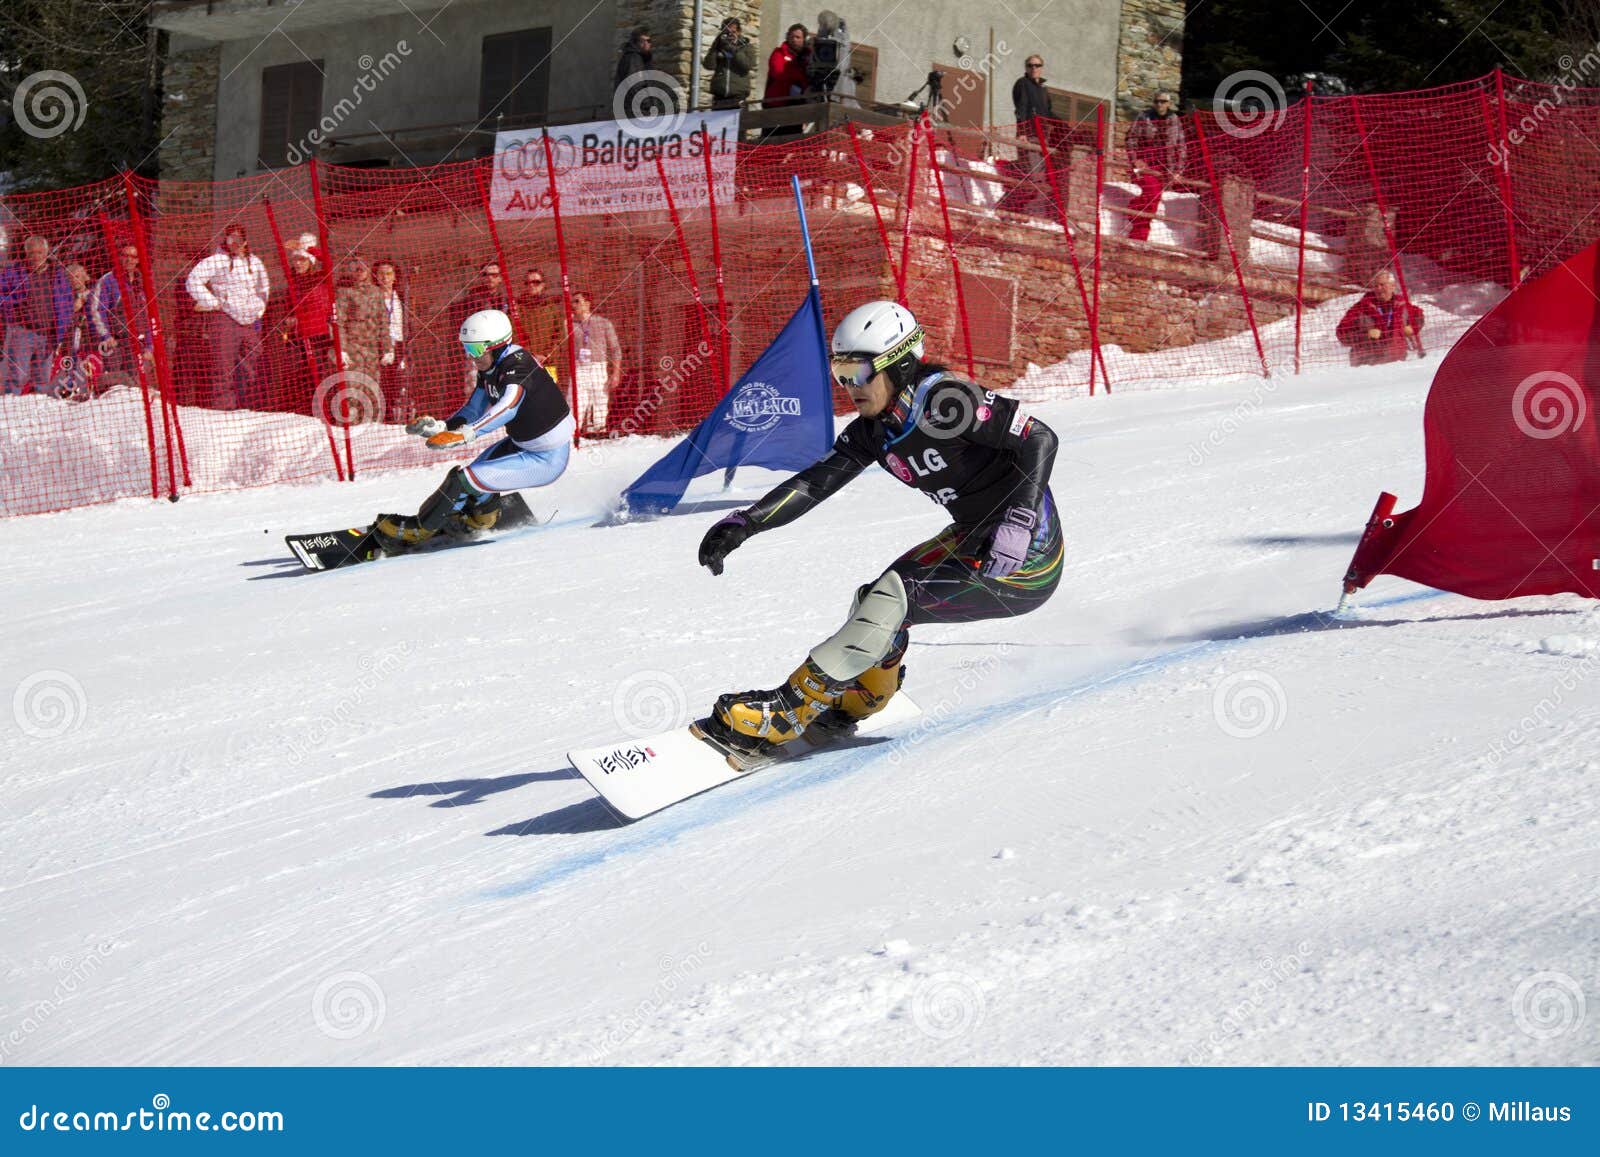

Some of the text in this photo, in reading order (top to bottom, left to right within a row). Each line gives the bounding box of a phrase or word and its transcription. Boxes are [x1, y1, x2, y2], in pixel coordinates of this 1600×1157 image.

[582, 130, 682, 171] Balgera
[504, 187, 553, 211] Aud
[886, 333, 921, 361] SWANS
[733, 399, 798, 416] MALENCO
[983, 390, 996, 406] LG
[907, 447, 949, 477] LG
[592, 745, 651, 775] KESSLER
